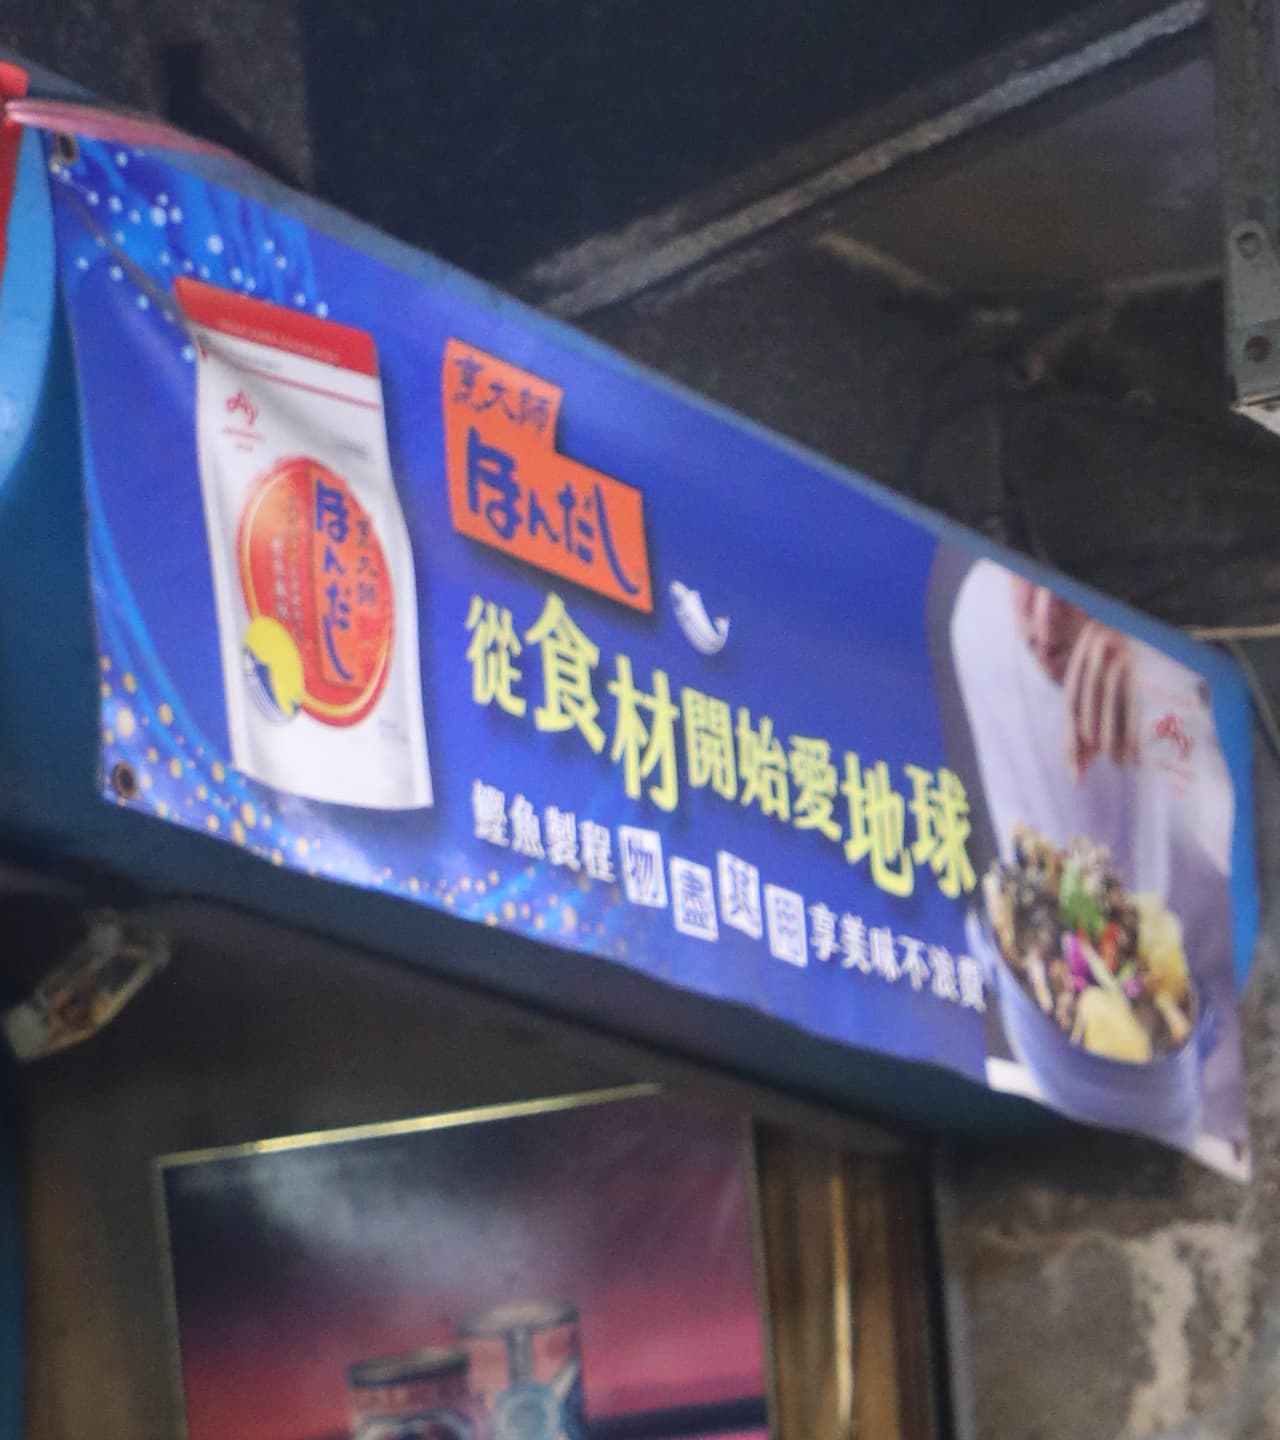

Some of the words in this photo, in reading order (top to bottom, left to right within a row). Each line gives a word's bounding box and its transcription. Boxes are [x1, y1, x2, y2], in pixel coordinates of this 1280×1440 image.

[455, 356, 551, 438] 烹大師
[314, 478, 354, 682] ほんだし
[466, 426, 640, 596] ほんだし
[466, 590, 977, 900] 從食材開始愛地球
